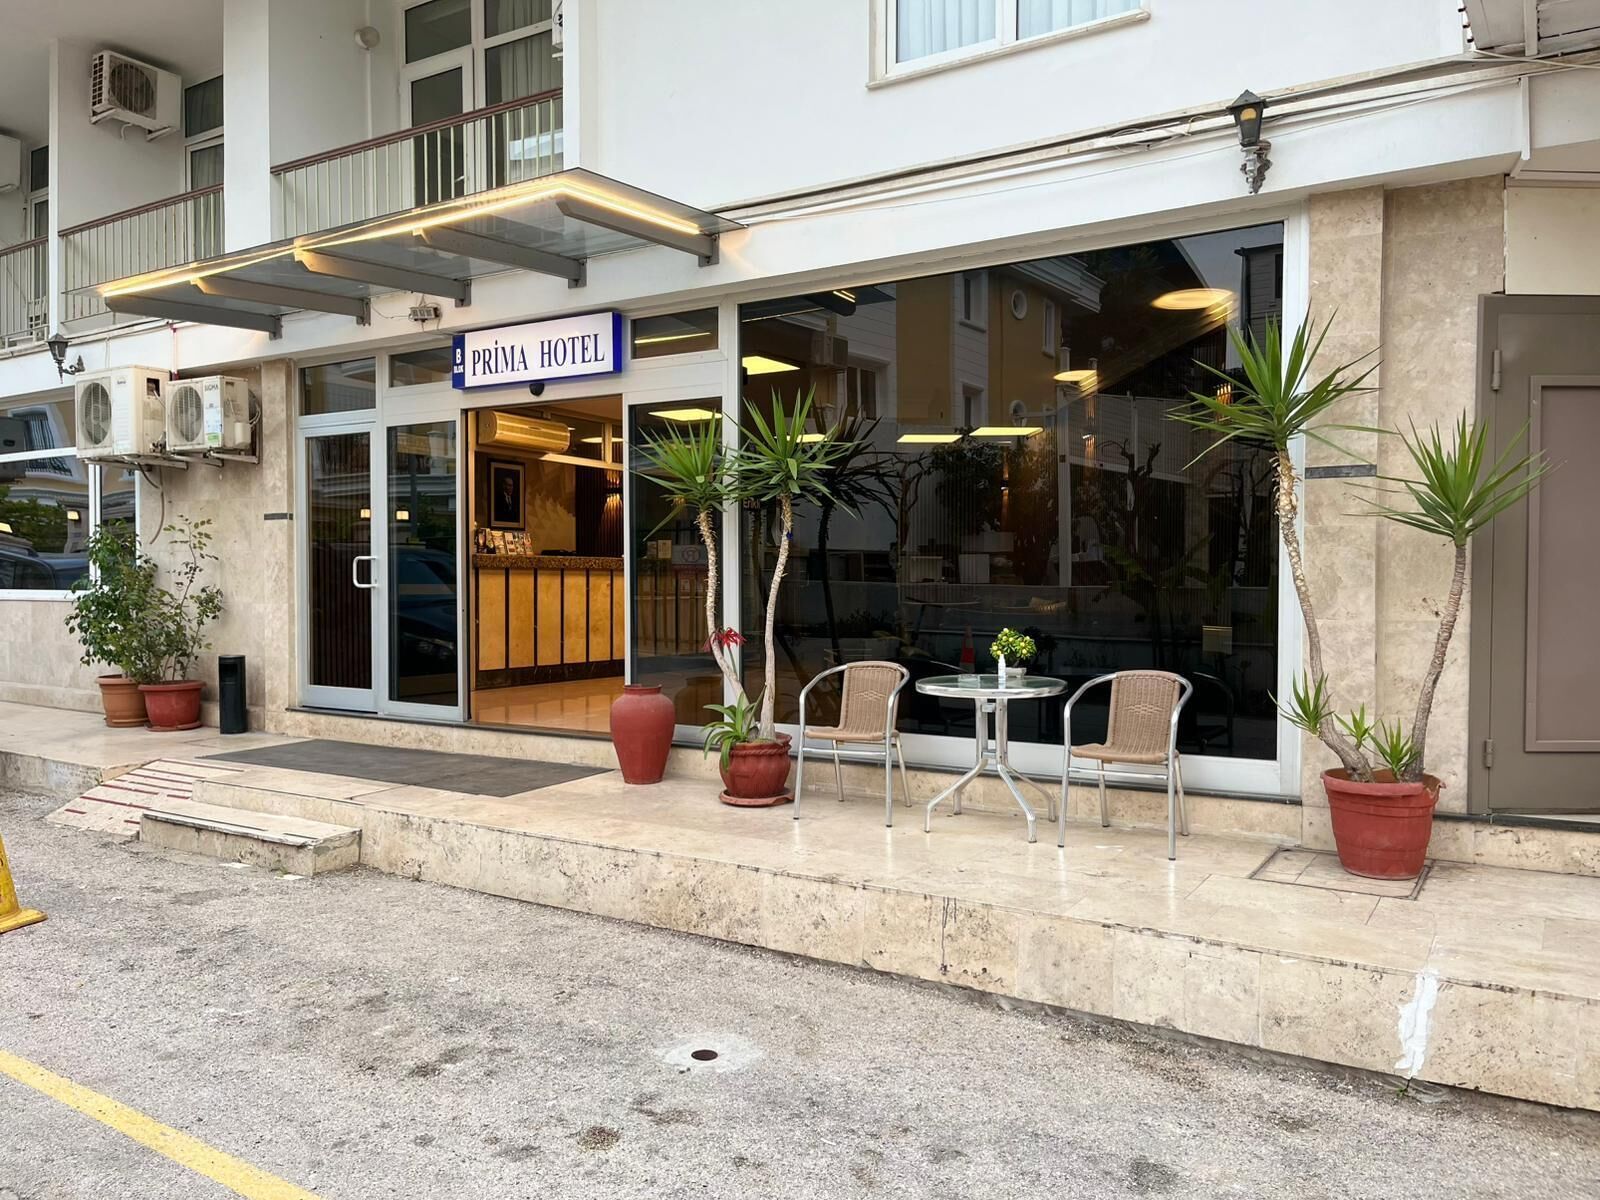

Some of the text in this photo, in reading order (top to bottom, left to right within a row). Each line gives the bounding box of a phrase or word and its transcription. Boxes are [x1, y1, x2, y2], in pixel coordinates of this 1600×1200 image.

[455, 349, 462, 364] B
[472, 333, 605, 376] PRİMA HOTEL
